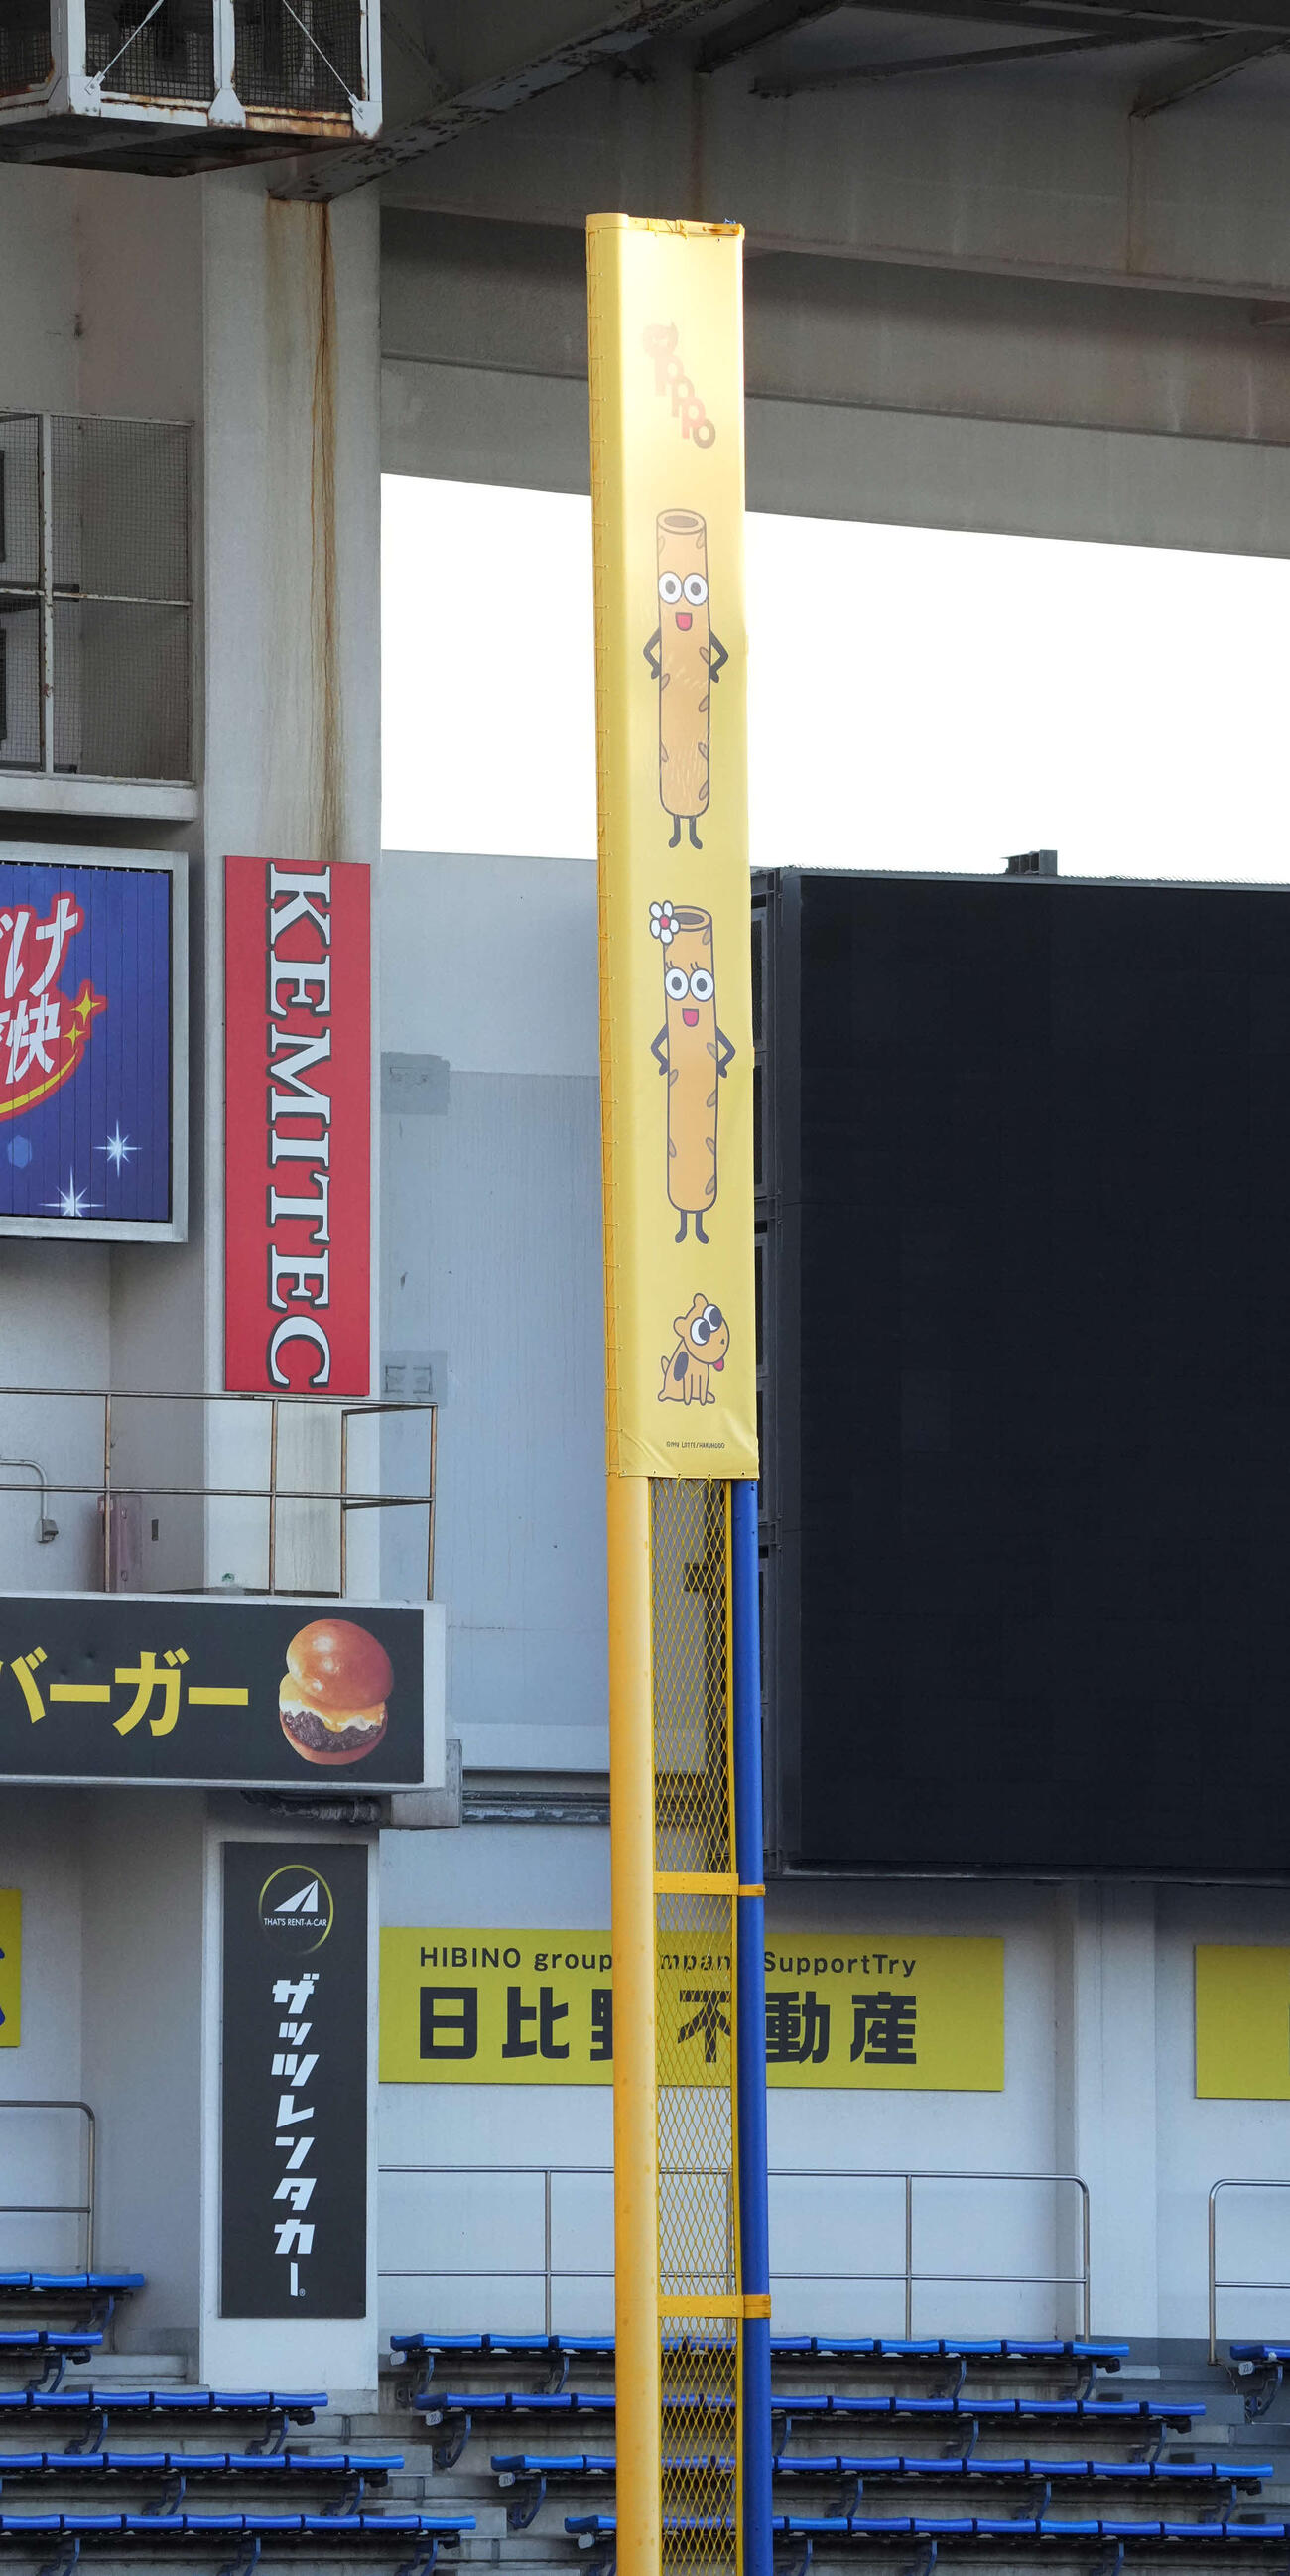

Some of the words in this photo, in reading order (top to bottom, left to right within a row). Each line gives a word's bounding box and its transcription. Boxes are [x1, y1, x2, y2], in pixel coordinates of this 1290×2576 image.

[267, 862, 332, 1389] KEMITEC
[264, 1917, 286, 1926] THAT'S
[287, 1918, 327, 1927] RENT-A-CAR
[420, 1947, 521, 1968] HIBINO
[534, 1952, 612, 1973] group
[764, 1951, 916, 1978] SupportTry
[271, 1972, 320, 2296] ザッツレンタカー
